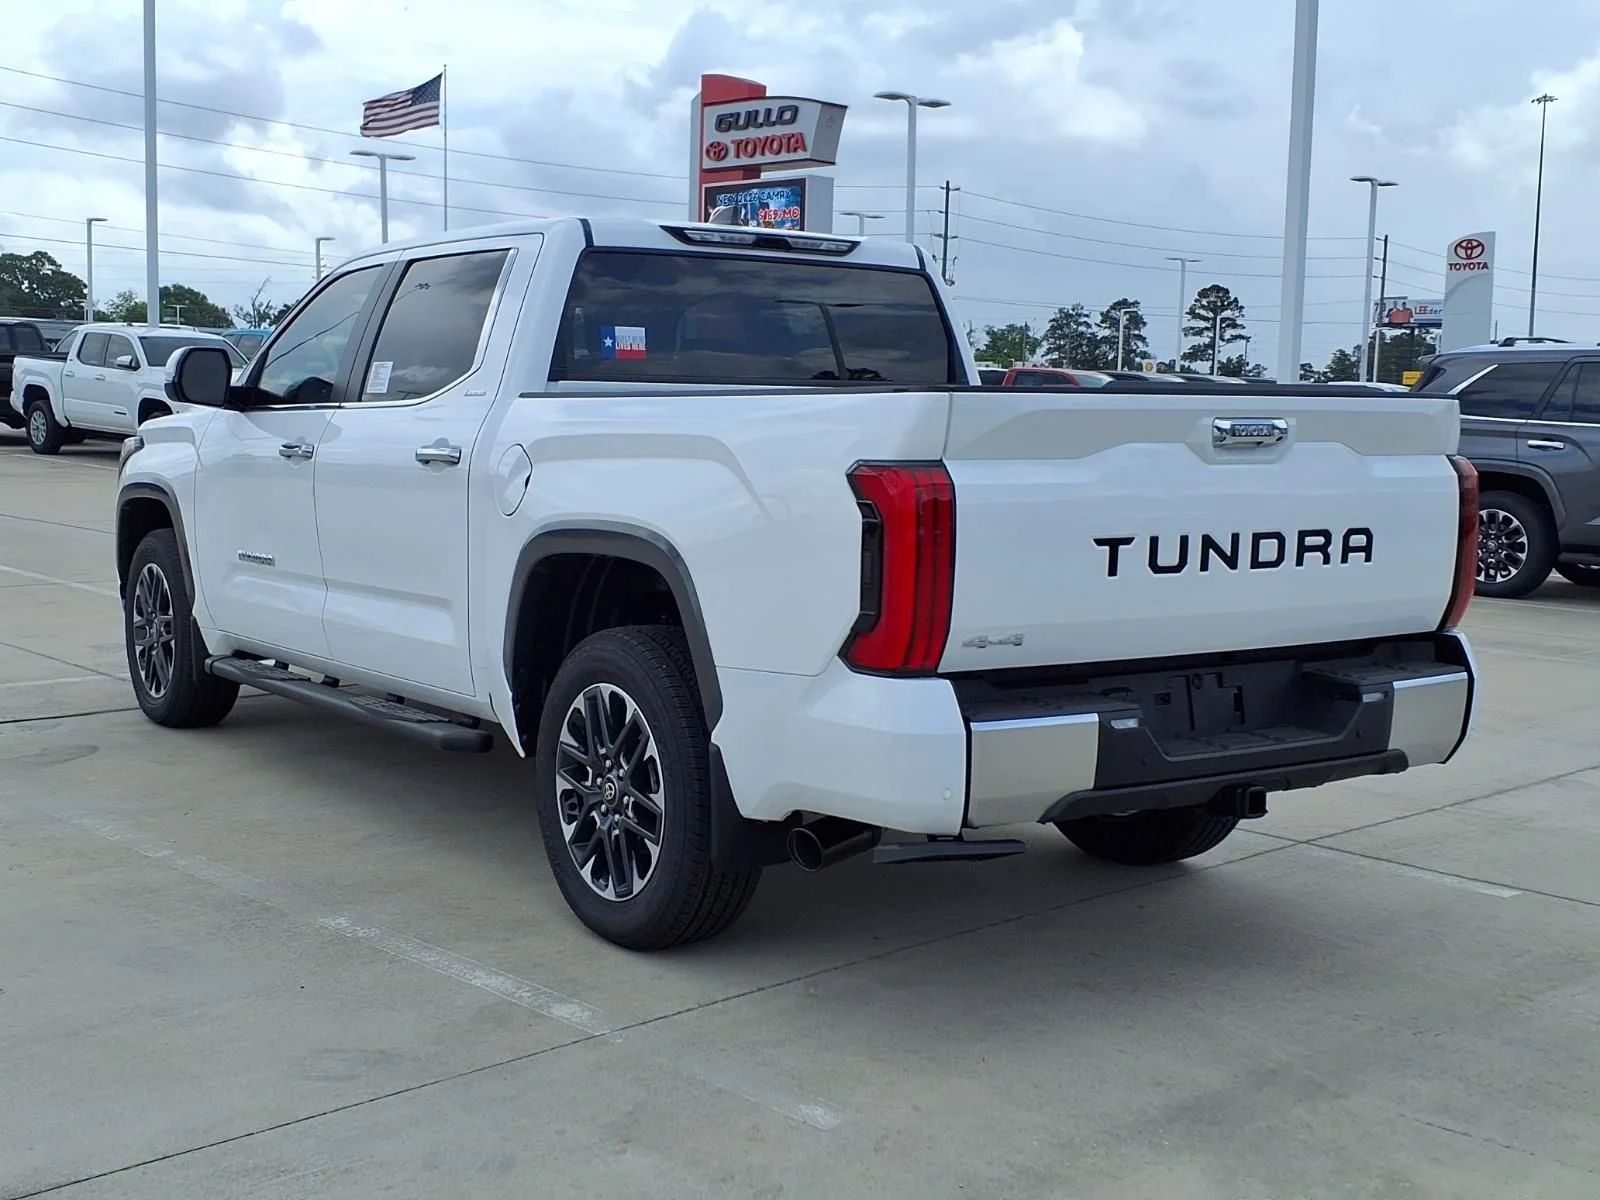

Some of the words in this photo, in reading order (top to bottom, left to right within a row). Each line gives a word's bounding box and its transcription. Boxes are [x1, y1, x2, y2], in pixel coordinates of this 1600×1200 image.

[714, 104, 799, 133] GULLO
[731, 132, 808, 159] TOYOTA
[759, 188, 791, 202] CAMRY
[1448, 261, 1489, 271] TOYOTA
[1234, 425, 1272, 436] TOYOTA
[1093, 527, 1374, 577] TUNDRA
